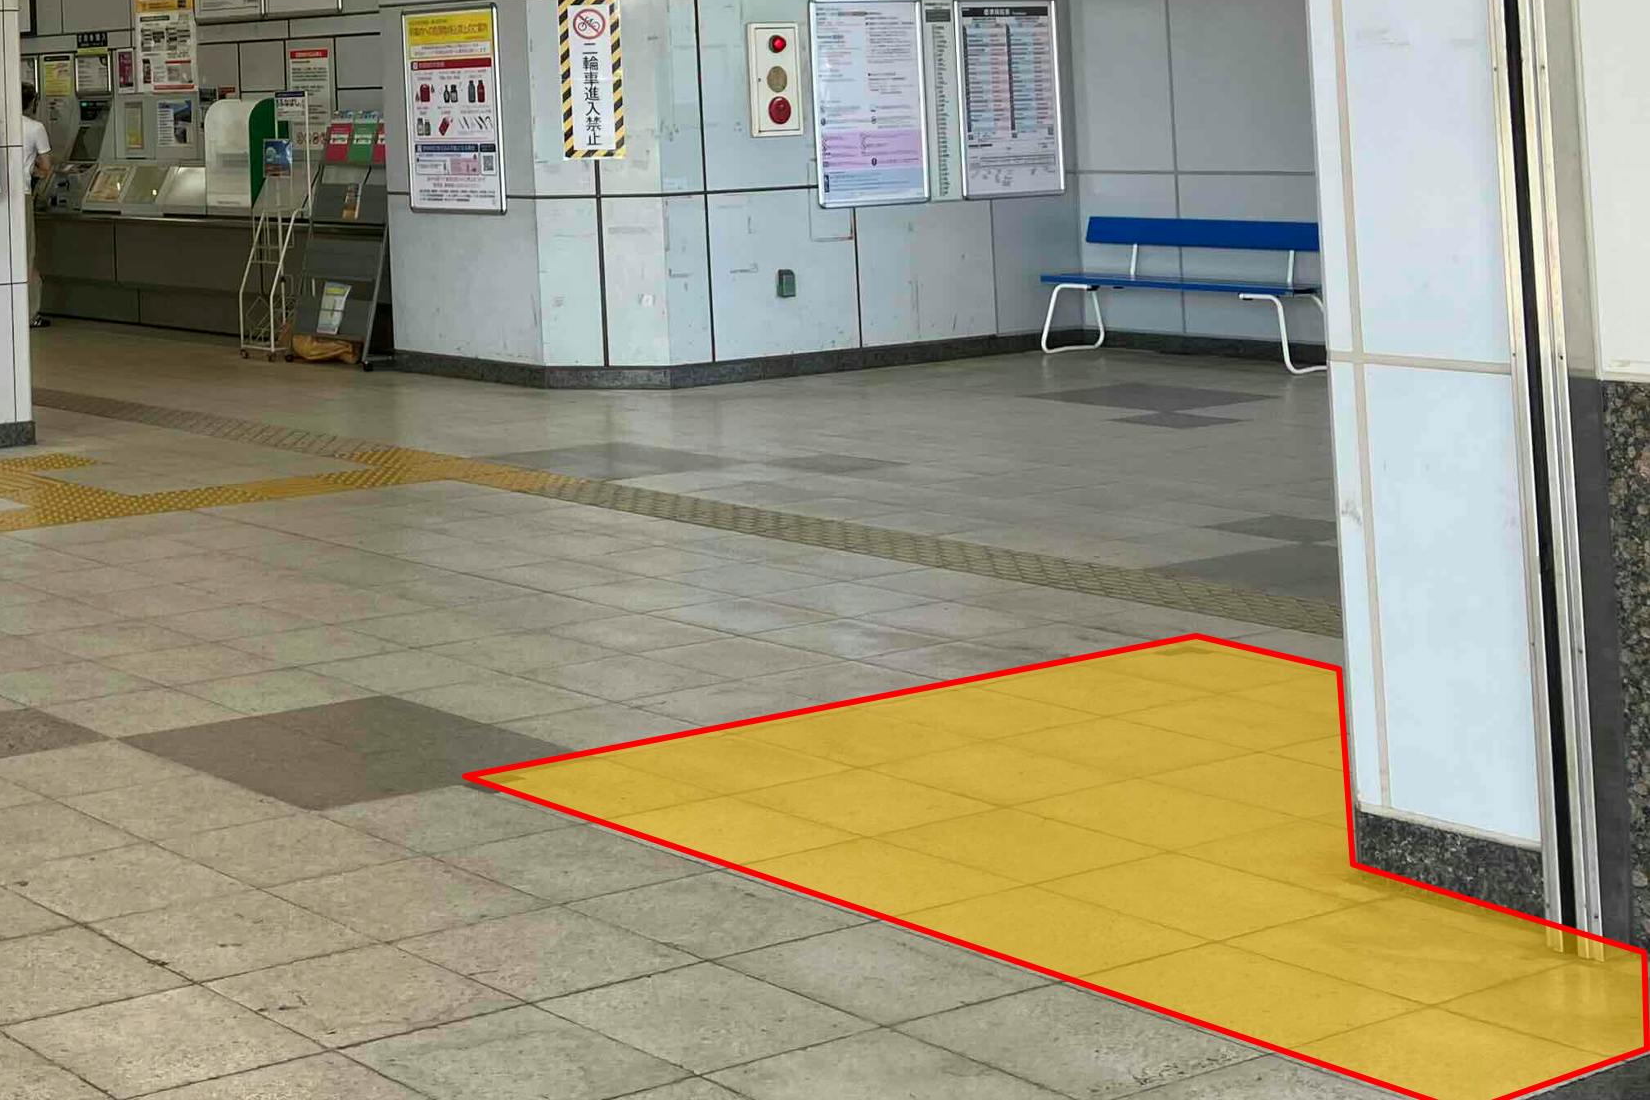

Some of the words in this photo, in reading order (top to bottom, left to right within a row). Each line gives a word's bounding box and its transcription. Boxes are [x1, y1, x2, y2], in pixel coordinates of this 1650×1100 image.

[582, 43, 603, 146] 二輪車進入禁止
